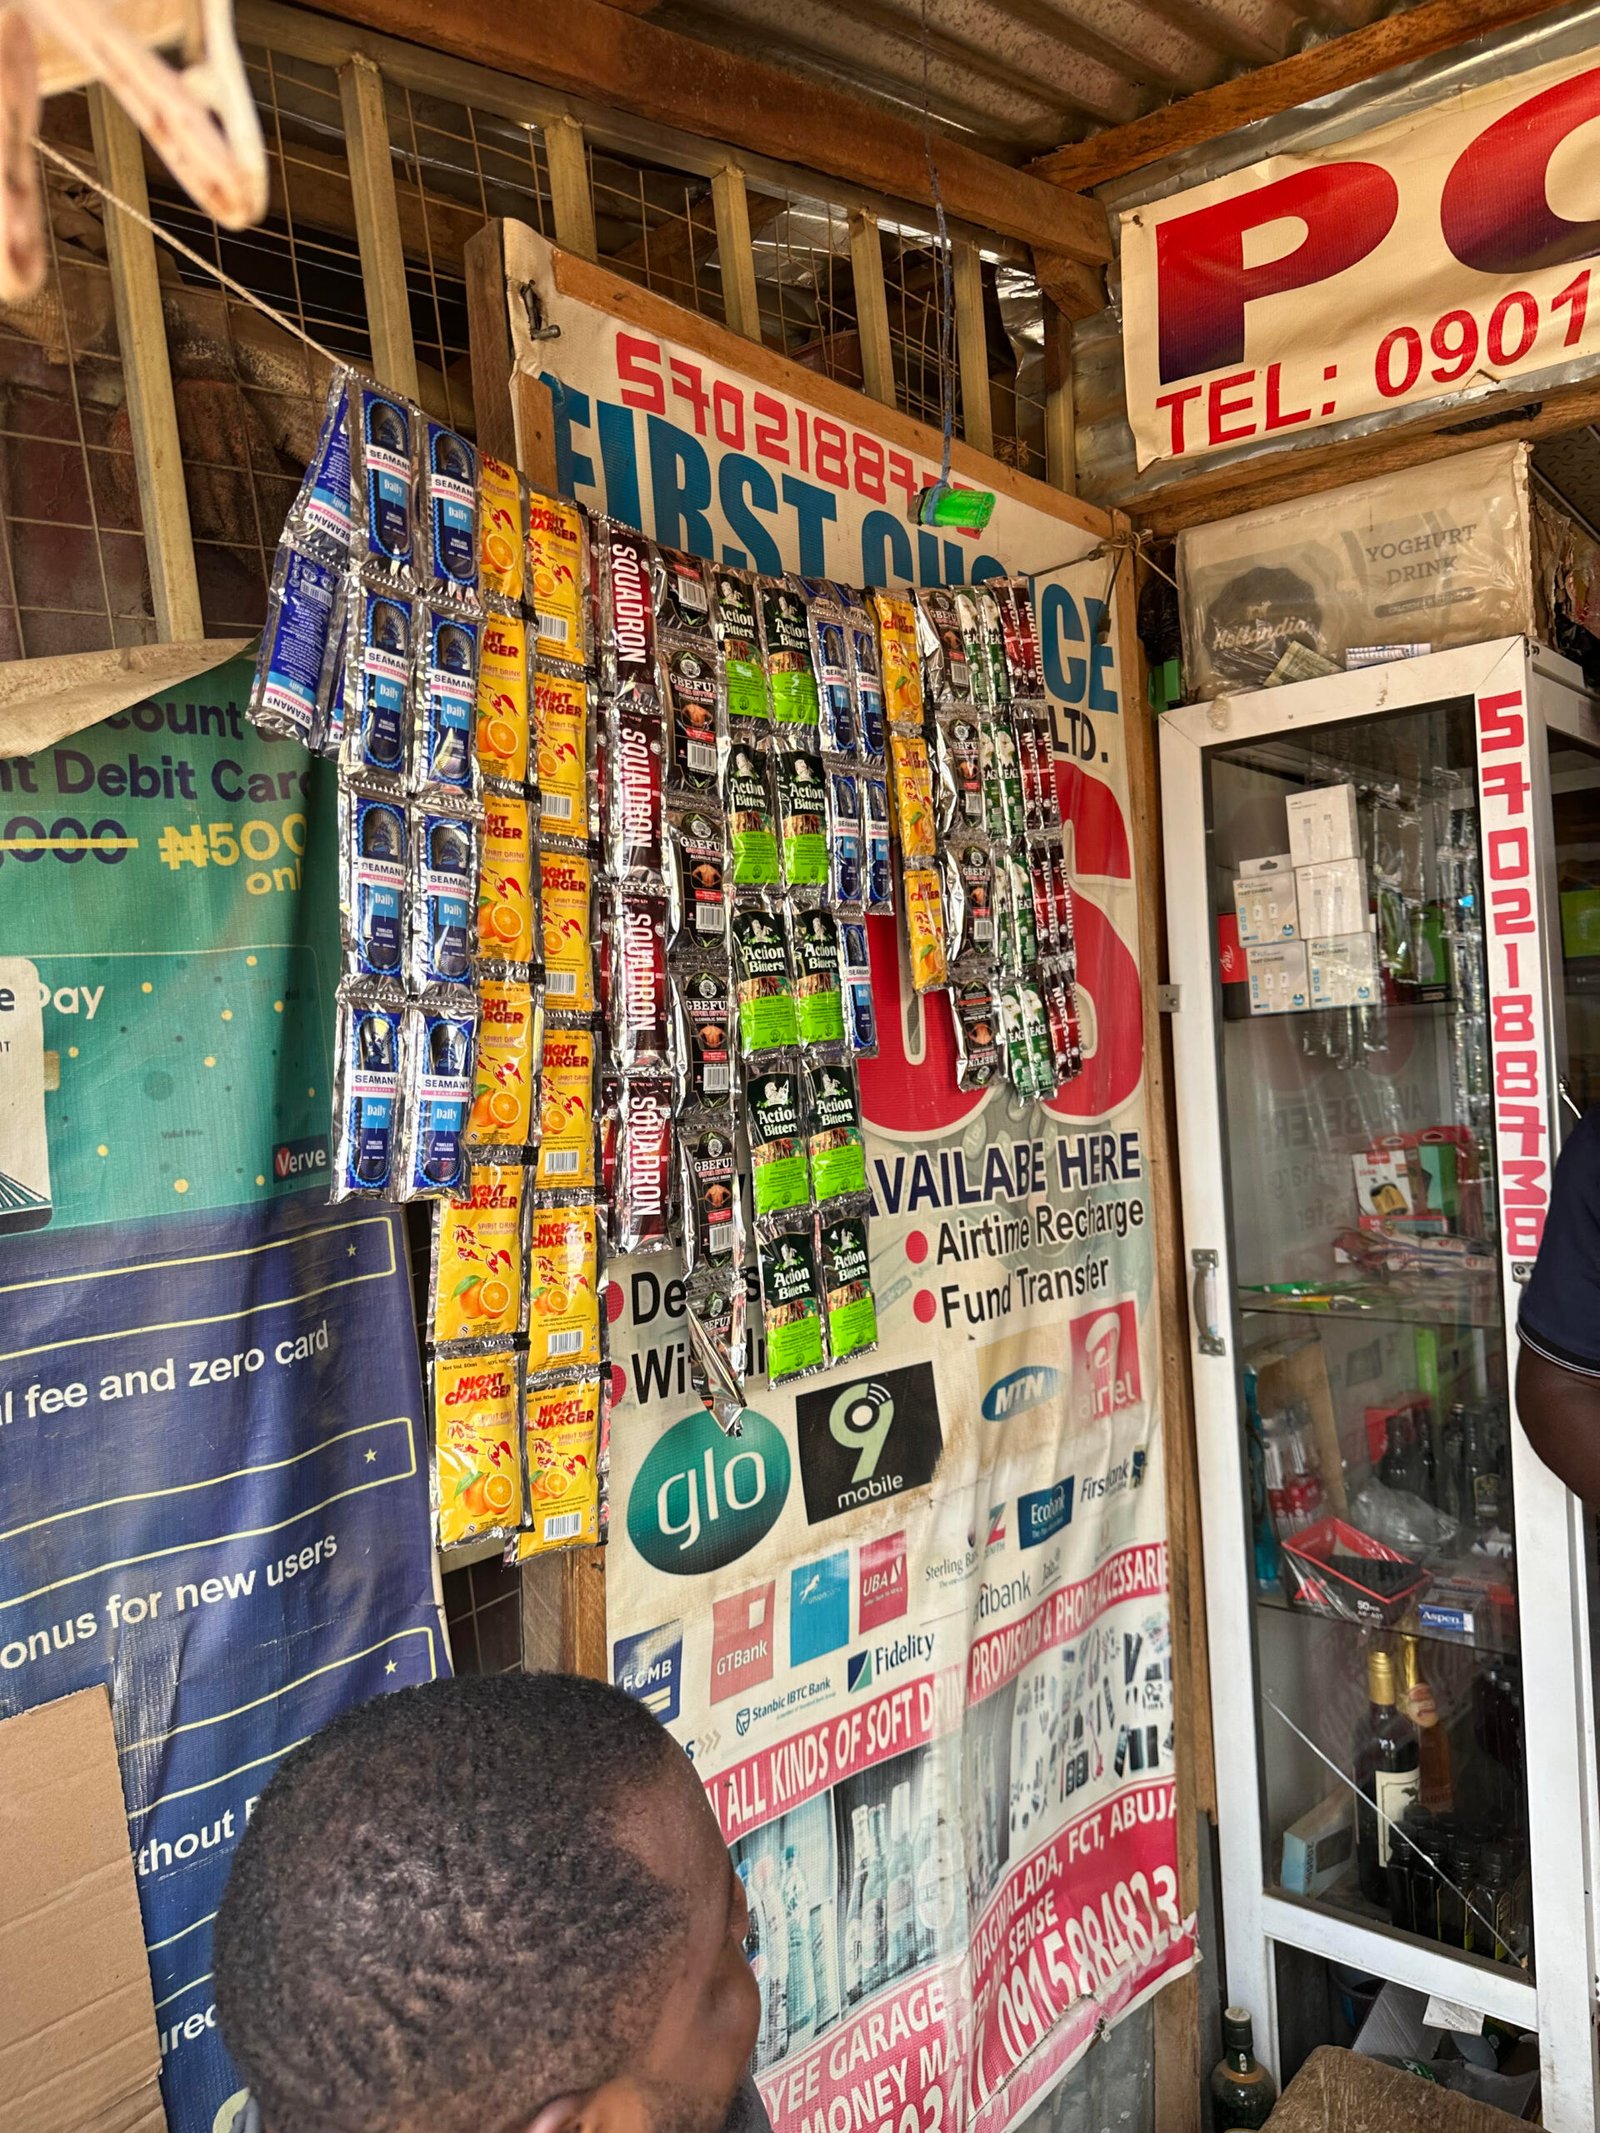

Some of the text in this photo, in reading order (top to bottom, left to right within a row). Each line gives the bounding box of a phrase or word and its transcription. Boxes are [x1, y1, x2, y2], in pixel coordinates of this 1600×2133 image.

[1156, 268, 1591, 456] TEL: 0901
[538, 371, 838, 580] FIRST
[384, 478, 403, 496] Daily
[449, 506, 467, 523] Daily
[1366, 524, 1477, 562] YOGHURT
[1387, 556, 1458, 585] DRINK
[611, 543, 646, 663] SQUADRON
[775, 618, 808, 638] Action
[380, 684, 399, 699] Daily
[447, 703, 466, 720] Daily
[54, 750, 197, 800] Debit
[731, 778, 764, 795] Action
[790, 782, 824, 799] Action
[735, 793, 765, 808] Bitters
[794, 798, 824, 811] Bitters
[246, 862, 304, 895] onl
[541, 866, 575, 879] IGHT
[542, 879, 586, 893] ARGER
[375, 892, 394, 907] Daily
[444, 903, 463, 917] Daily
[744, 945, 785, 961] Action
[804, 944, 837, 958] Action
[626, 912, 656, 1031] SQUADRON
[749, 958, 785, 972] Bitters
[809, 956, 837, 970] Bitters
[686, 1000, 727, 1011] GBEFU
[484, 1011, 524, 1024] RGER
[367, 1104, 386, 1117] Daily
[436, 1108, 458, 1121] Daily
[817, 1098, 853, 1115] Action
[764, 1121, 798, 1136] Bitters
[277, 1148, 327, 1176] Verve
[630, 1095, 661, 1216] SQUADRON
[1058, 1132, 1141, 1188] HERE
[471, 1184, 507, 1197] IGHT
[937, 1198, 1143, 1265] Airtime Recharge
[834, 1250, 866, 1270] Action
[774, 1266, 810, 1287] Action
[941, 1256, 1108, 1328] Fund Transfer
[25, 1320, 329, 1414] fee and zero card
[458, 1372, 504, 1391] NIGHT
[444, 1384, 511, 1406] CHARGER
[995, 1371, 1045, 1415] MTN
[539, 1399, 583, 1419] NIGHT
[657, 1447, 766, 1550] glo
[837, 1471, 903, 1508] mobile
[925, 1558, 964, 1581] Sterling
[863, 1570, 888, 1597] UBA
[0, 1534, 337, 1670] onus for new users
[1422, 1610, 1459, 1625] Aspen
[716, 1640, 767, 1676] GTBank
[875, 1633, 935, 1675] Fidelity
[624, 1659, 672, 1691] FCMB
[752, 1697, 785, 1721] Stanbic
[787, 1685, 807, 1705] IBTC
[809, 1677, 831, 1696] Bank
[727, 1762, 766, 1832] ALL
[771, 1727, 829, 1806] KINDS
[835, 1712, 862, 1769] OF
[866, 1687, 913, 1756] SOFT
[919, 1669, 963, 1732] DRIN
[1008, 1888, 1059, 1966] SENSE
[829, 1981, 947, 2081] GARAGE
